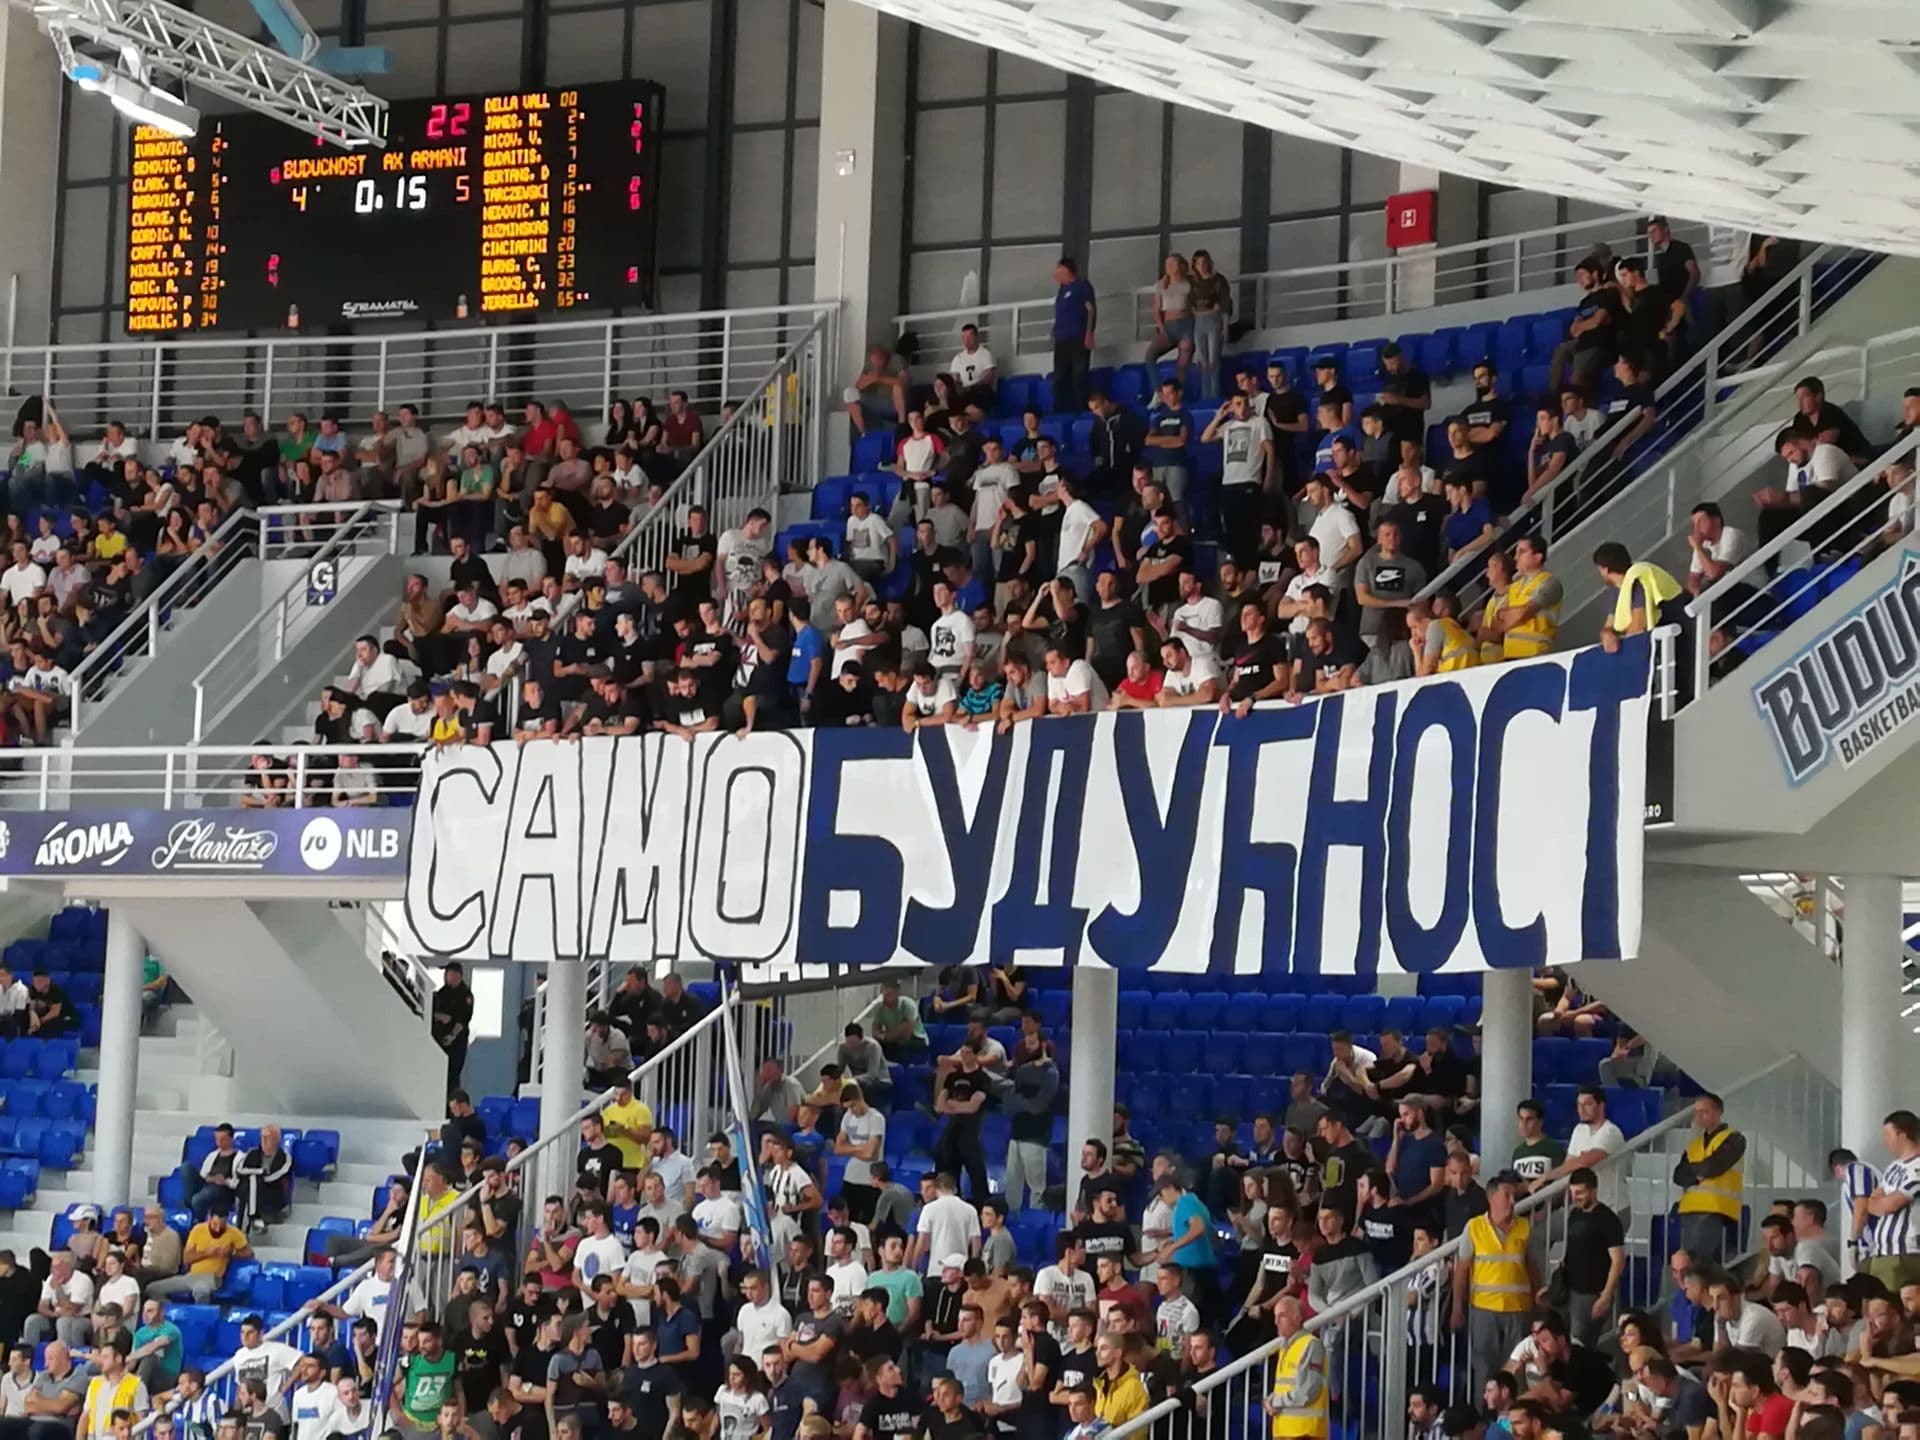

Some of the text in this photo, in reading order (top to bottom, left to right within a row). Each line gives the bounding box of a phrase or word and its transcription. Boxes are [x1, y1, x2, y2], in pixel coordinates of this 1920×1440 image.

[427, 103, 470, 137] 22
[568, 127, 577, 141] 5
[283, 155, 367, 180] BUDUCNOST
[383, 152, 403, 171] AX
[411, 147, 467, 169] ARMANI
[568, 164, 577, 179] 9
[292, 186, 307, 211] 4
[456, 175, 470, 201] 5
[563, 181, 576, 197] 15
[210, 190, 219, 205] 6
[563, 199, 576, 214] 16
[206, 225, 219, 240] 10
[563, 217, 576, 233] 19
[205, 241, 218, 256] 14
[557, 235, 575, 251] 20
[205, 259, 218, 274] 19
[557, 254, 575, 269] 23
[200, 276, 218, 291] 23
[200, 312, 217, 328] 34
[312, 562, 333, 590] G
[35, 821, 134, 866] AROMA
[347, 828, 399, 858] NLB
